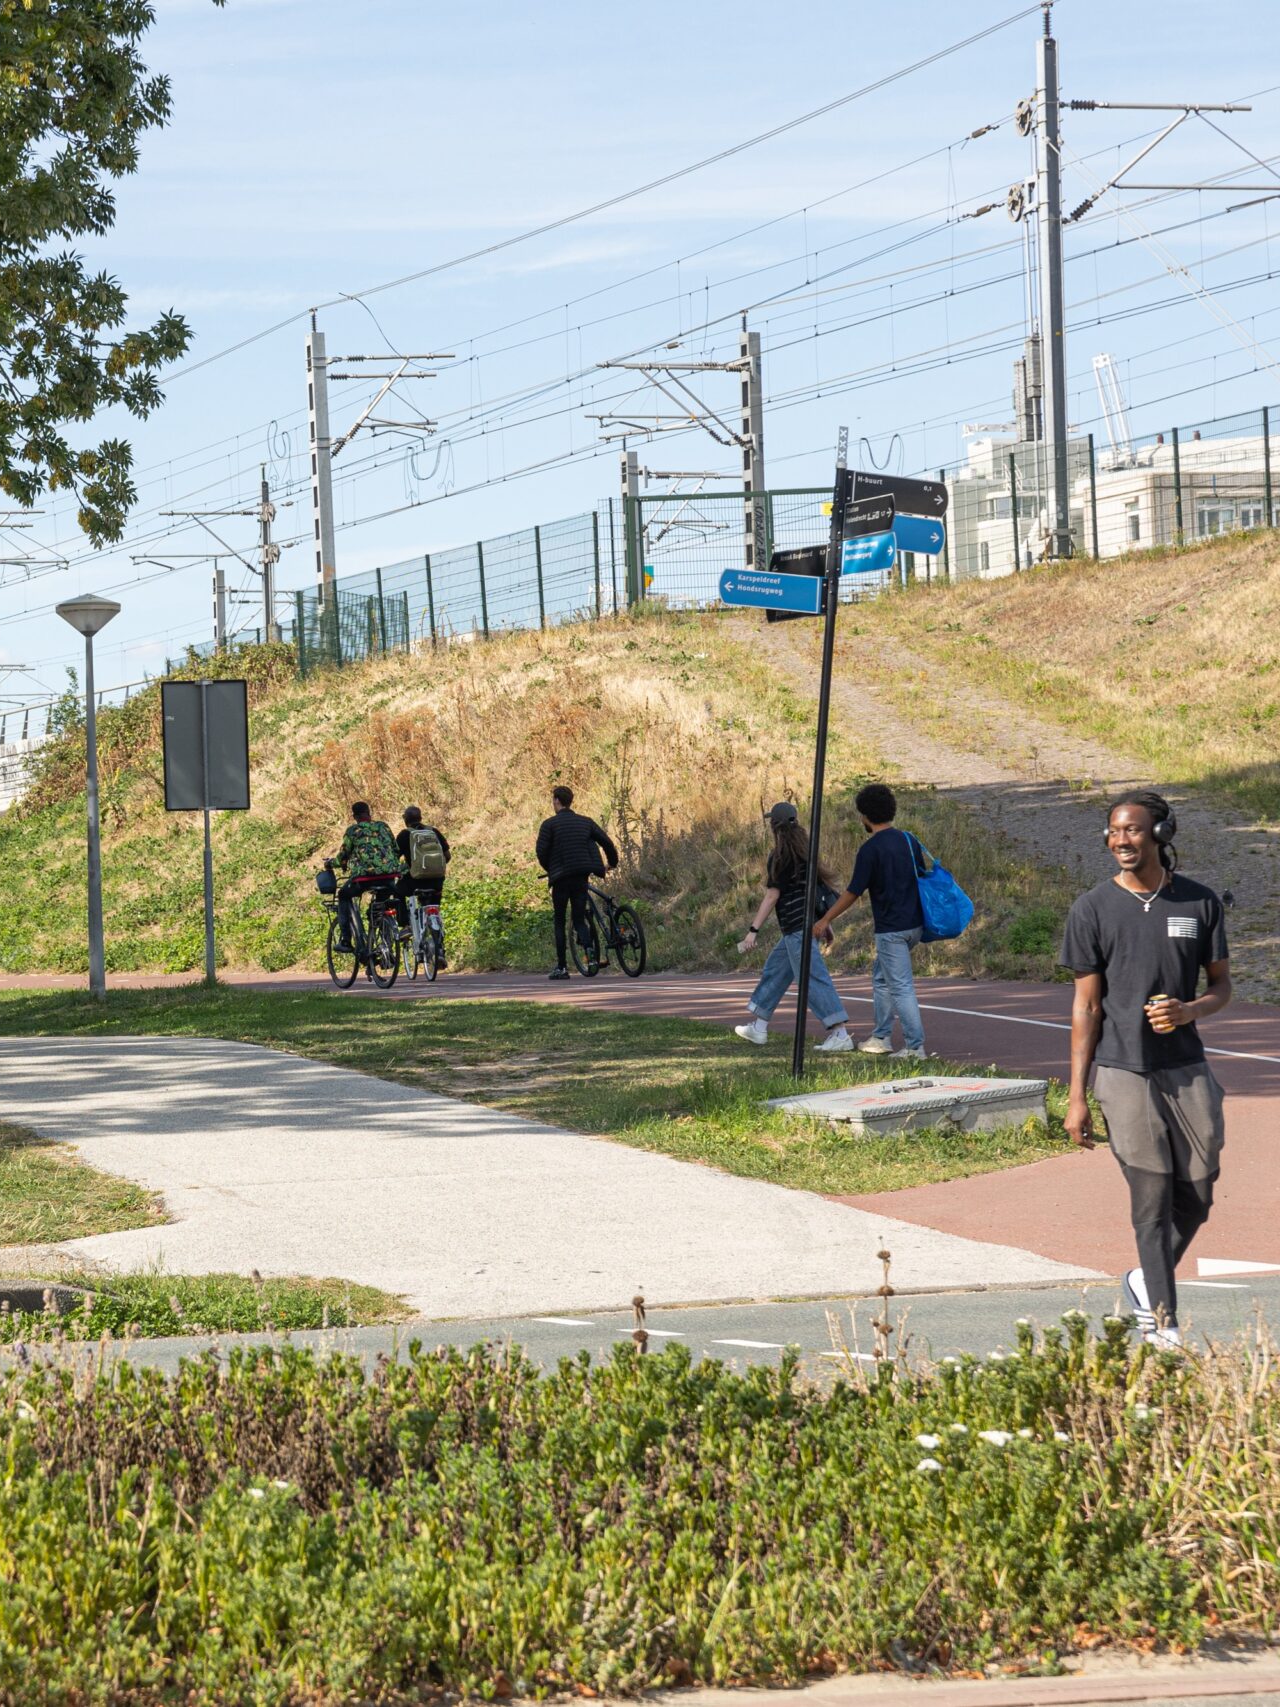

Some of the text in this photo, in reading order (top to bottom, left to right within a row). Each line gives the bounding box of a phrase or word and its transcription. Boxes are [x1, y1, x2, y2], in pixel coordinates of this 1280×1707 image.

[857, 475, 883, 486] H-buurt
[738, 574, 781, 585] Karspeldreef
[737, 584, 783, 596] Hondsrugweg
